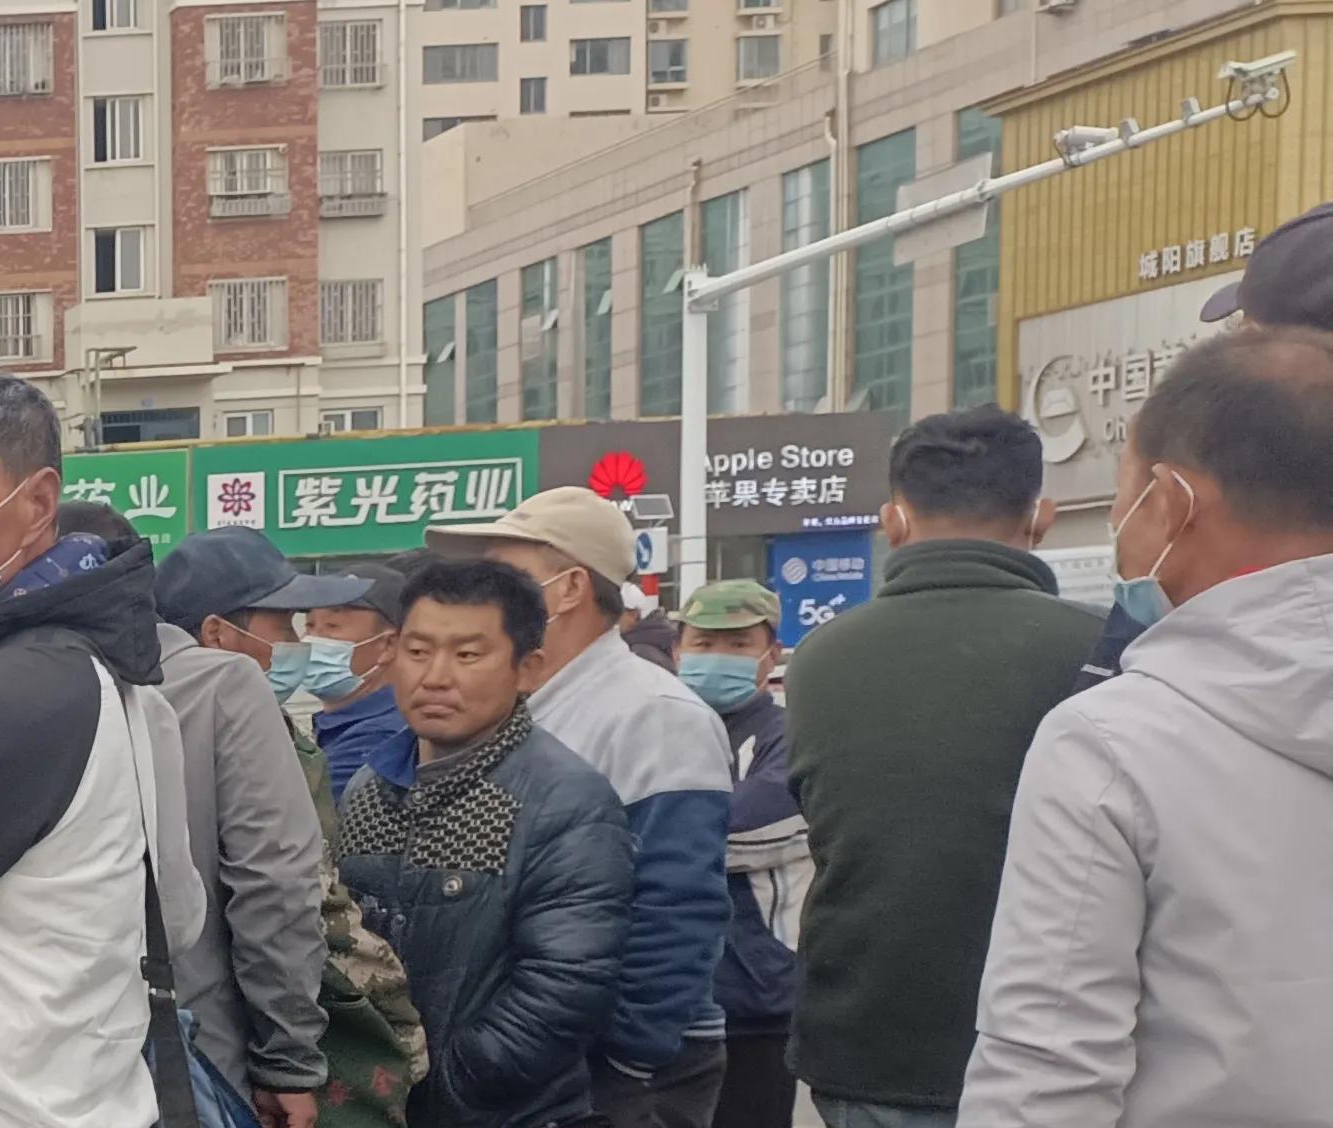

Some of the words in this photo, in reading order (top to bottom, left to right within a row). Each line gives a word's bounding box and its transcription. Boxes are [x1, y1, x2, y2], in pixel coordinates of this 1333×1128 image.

[1089, 345, 1178, 406] 中国
[781, 445, 855, 469] Store
[291, 468, 513, 527] 紫光药业
[704, 475, 847, 508] 苹果专卖店
